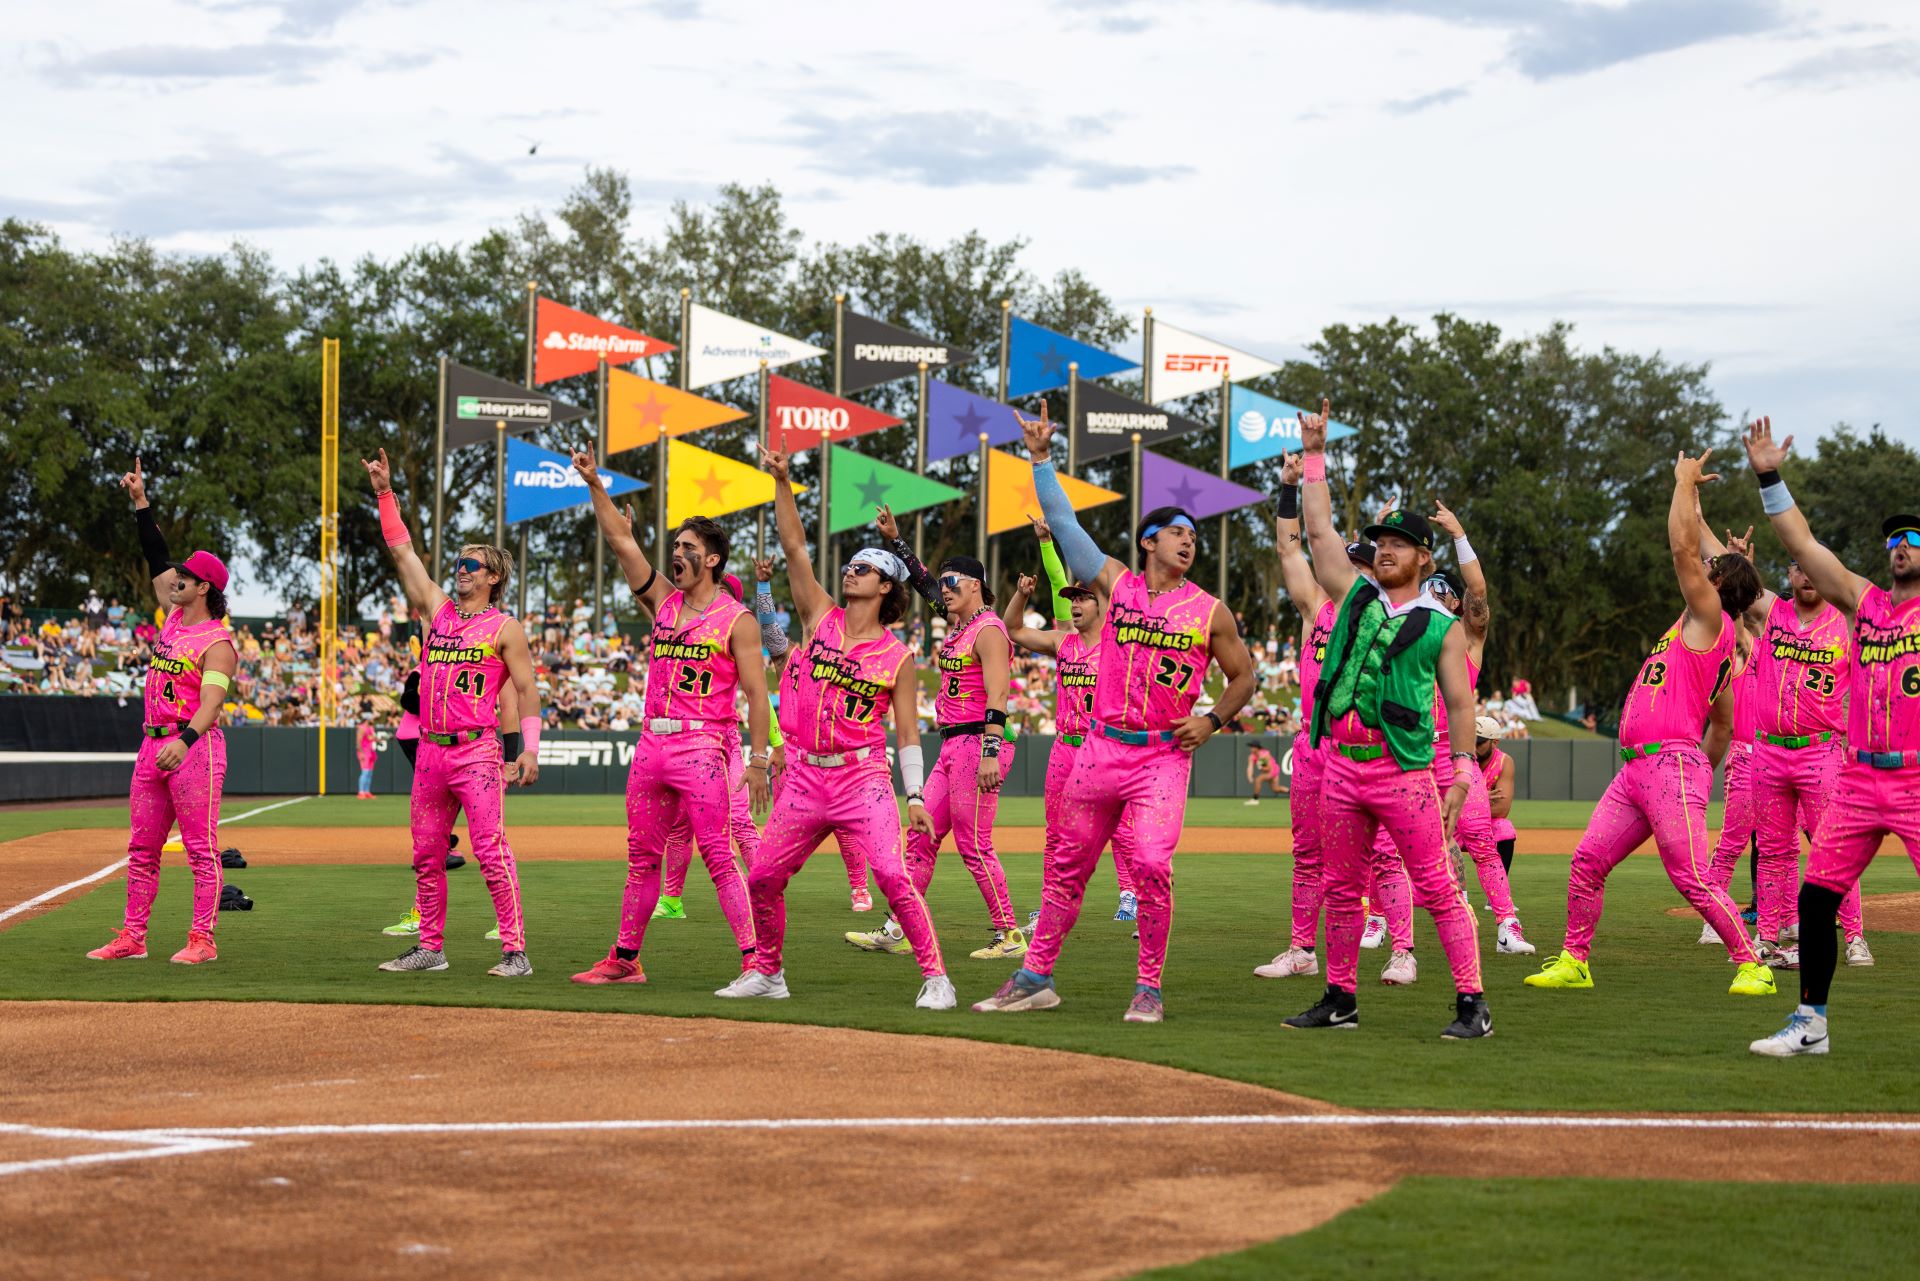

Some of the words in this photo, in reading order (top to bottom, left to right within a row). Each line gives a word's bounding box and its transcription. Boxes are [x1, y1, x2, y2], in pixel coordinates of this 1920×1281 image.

[854, 344, 949, 364] POWERADE
[1165, 354, 1229, 372] ESPN
[462, 402, 550, 419] enterprise
[776, 406, 849, 431] TORO
[1086, 412, 1169, 430] BODYARMOR
[1770, 628, 1813, 649] PARTY
[427, 649, 482, 664] ANIMALS
[653, 643, 709, 660] ANIMALS
[1773, 645, 1834, 664] ANIMALS
[454, 670, 486, 698] 41
[678, 665, 713, 697] 21
[1062, 674, 1097, 688] ANIMAL
[1155, 655, 1194, 694] 27
[1641, 661, 1668, 687] 13
[1804, 668, 1836, 697] 25
[162, 680, 176, 704] 4
[947, 676, 960, 698] 8
[844, 695, 877, 723] 17
[537, 740, 613, 766] ESPN
